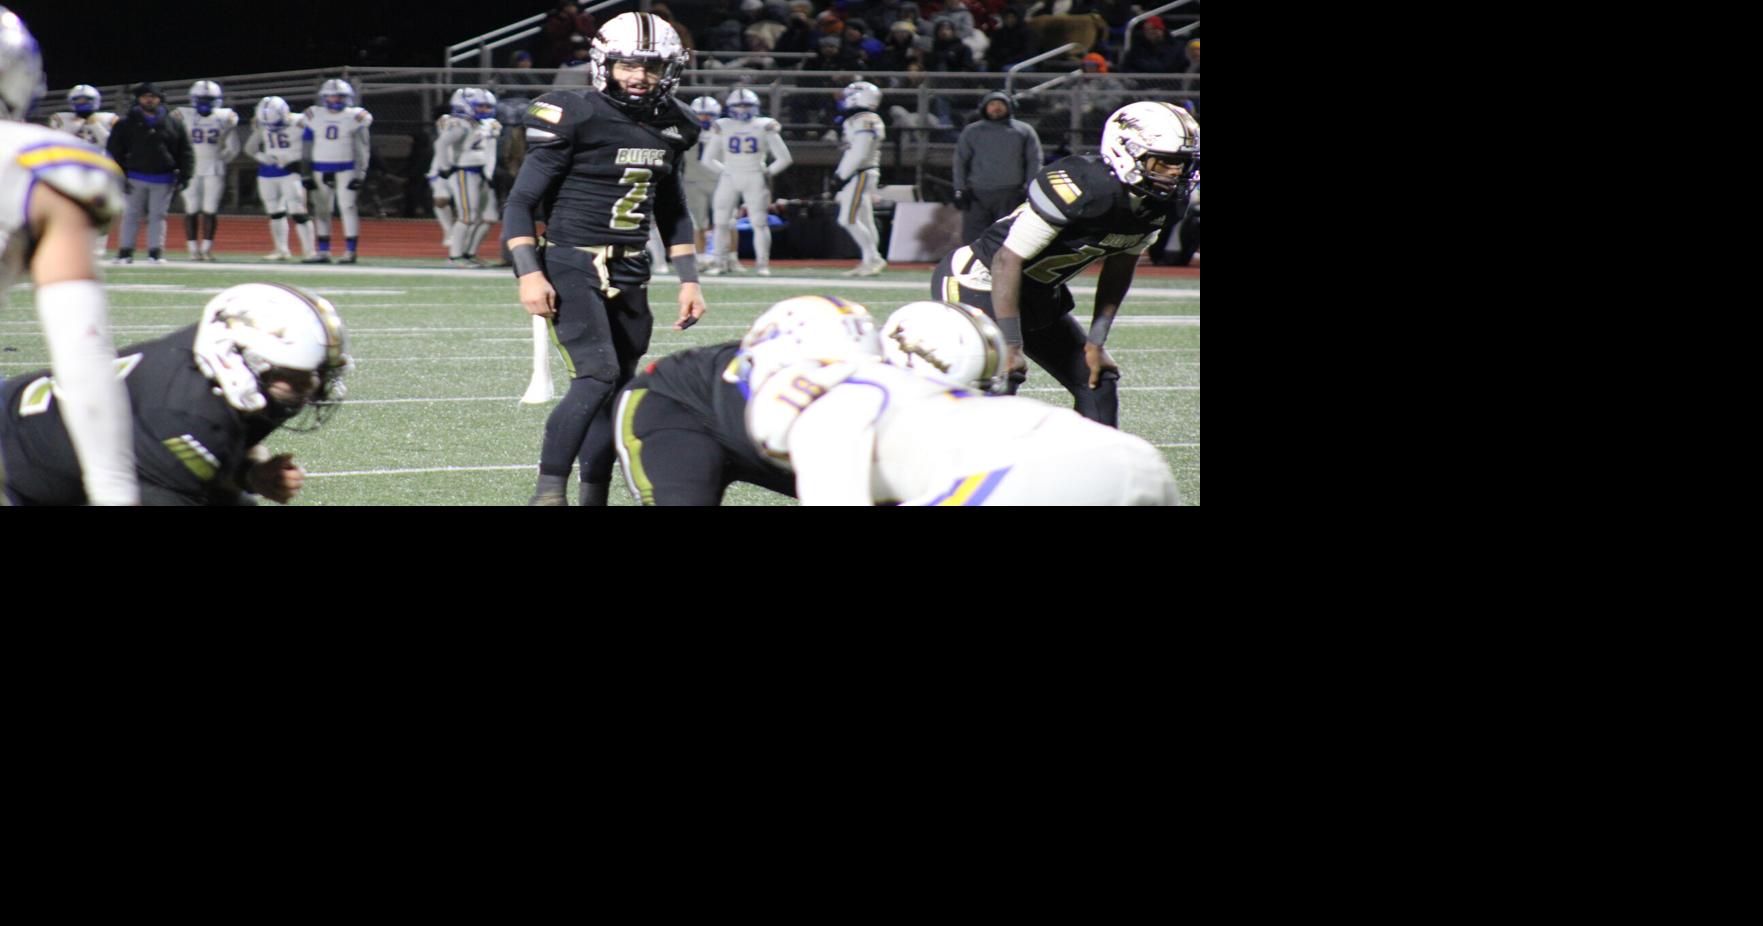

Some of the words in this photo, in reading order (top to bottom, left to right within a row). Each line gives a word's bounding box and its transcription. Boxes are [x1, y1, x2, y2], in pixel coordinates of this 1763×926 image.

[191, 128, 219, 144] 92
[268, 132, 290, 149] 16
[728, 136, 758, 154] 93
[609, 167, 653, 231] 2
